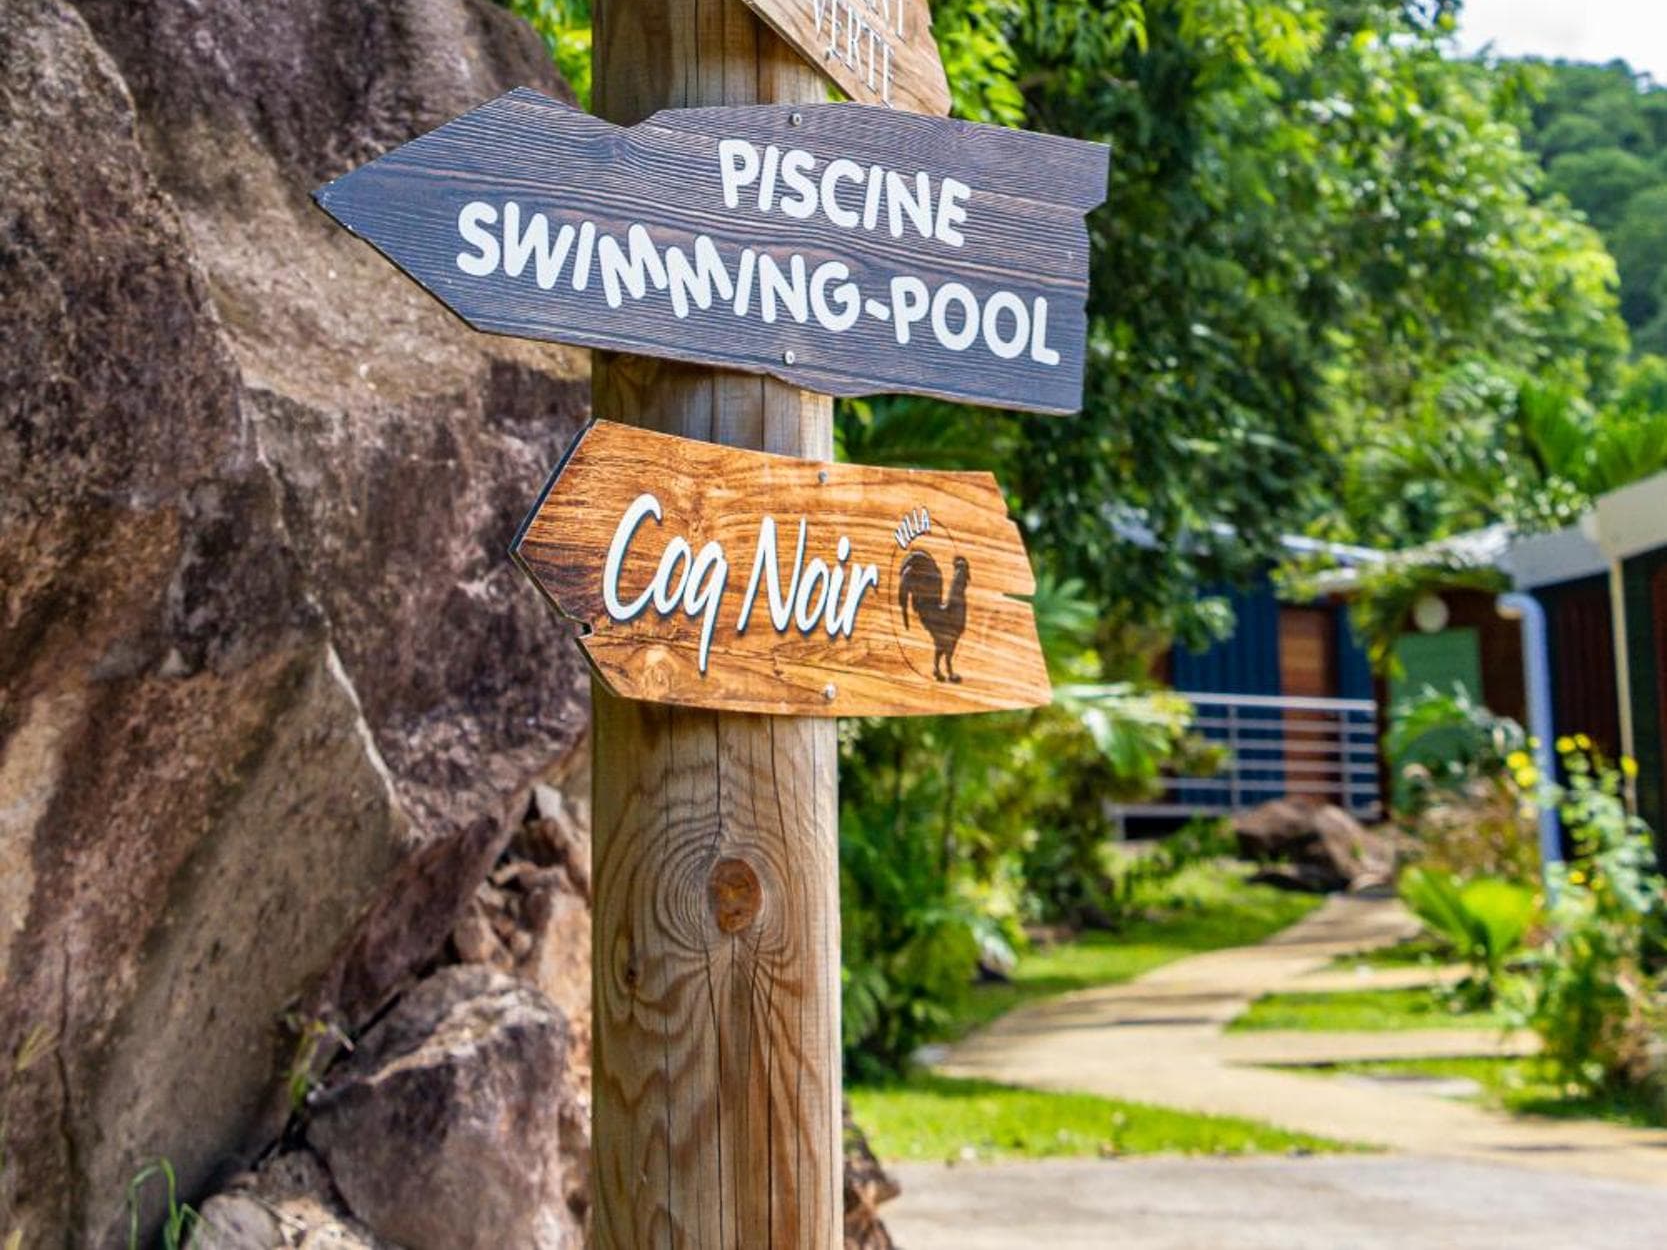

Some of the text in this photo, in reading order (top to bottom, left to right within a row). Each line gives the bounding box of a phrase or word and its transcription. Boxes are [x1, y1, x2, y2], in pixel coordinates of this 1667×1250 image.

[719, 139, 972, 247] PISCINE
[457, 200, 1060, 365] SWIMMING-POOL
[603, 493, 878, 674] Coq Noir
[894, 506, 931, 550] VILLA
